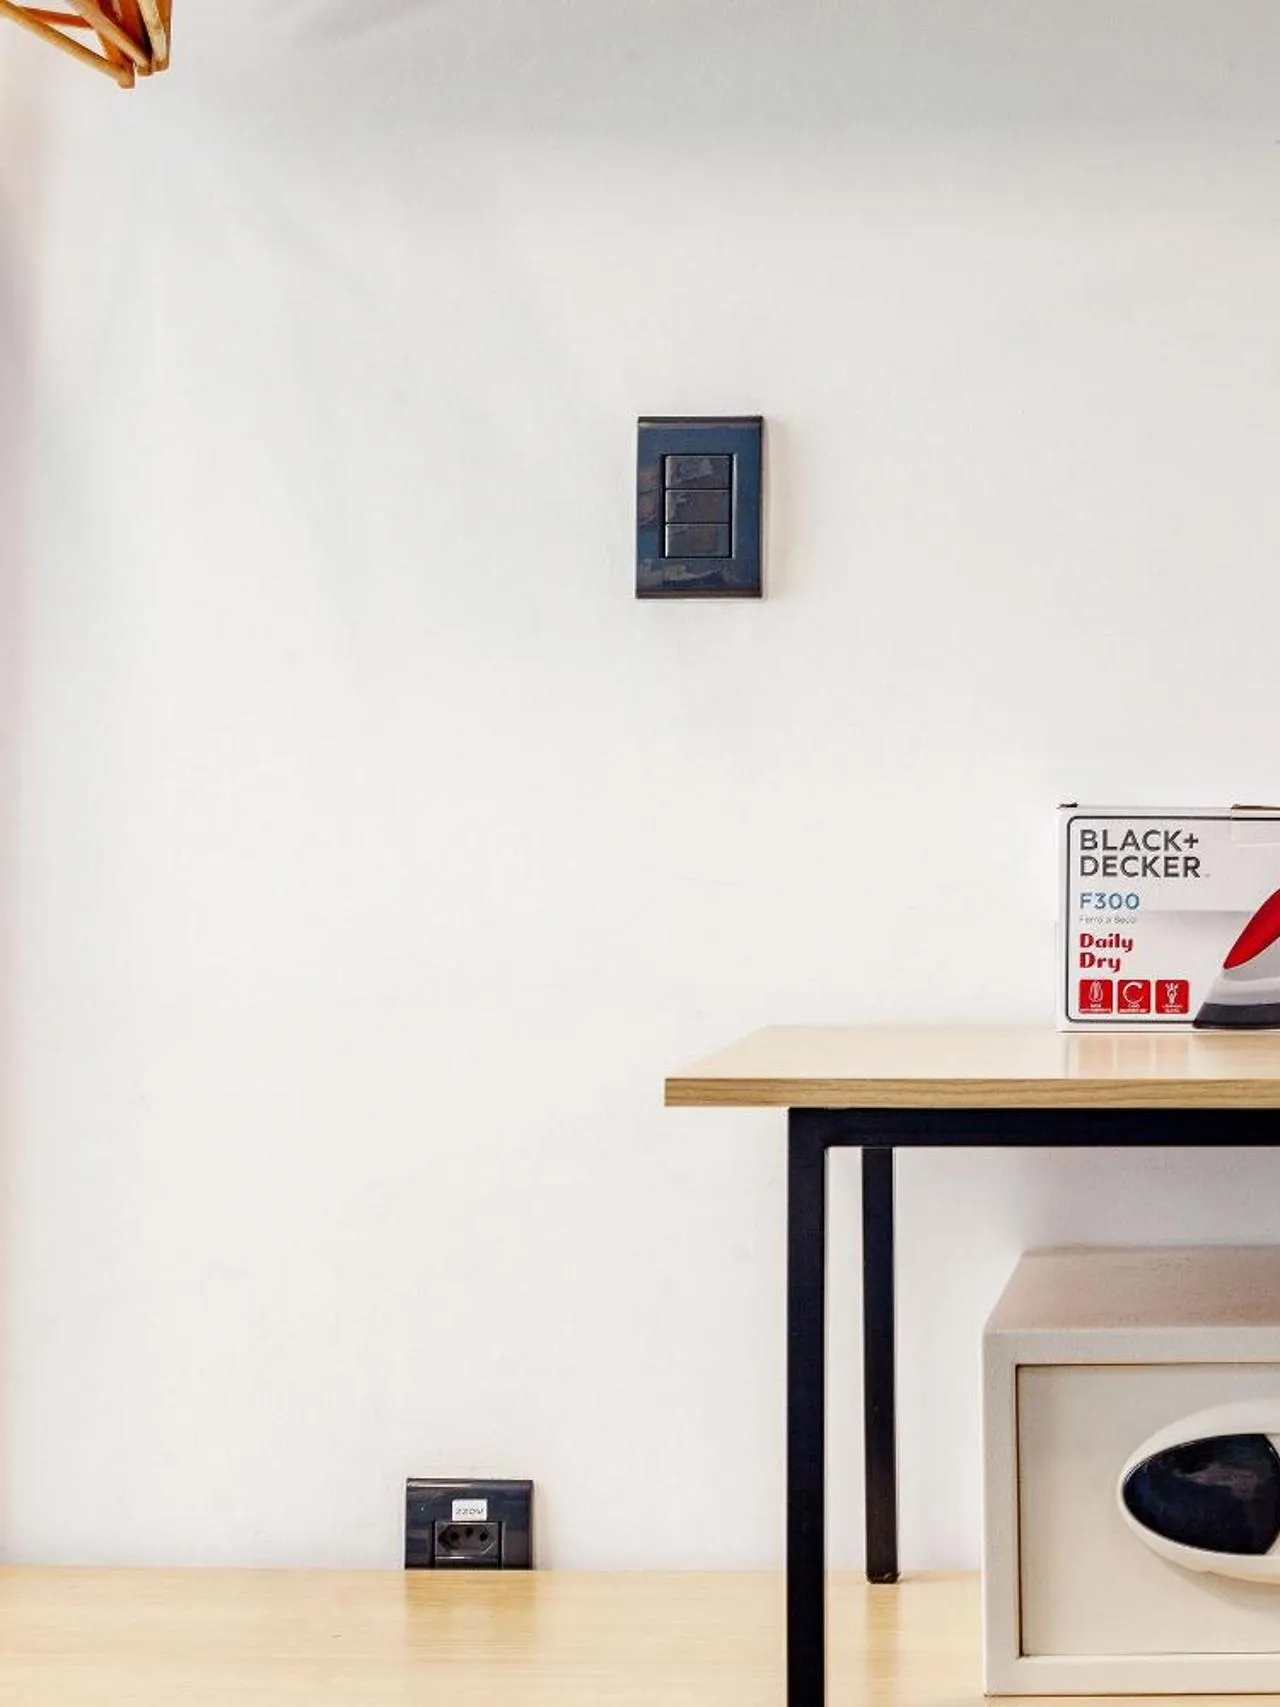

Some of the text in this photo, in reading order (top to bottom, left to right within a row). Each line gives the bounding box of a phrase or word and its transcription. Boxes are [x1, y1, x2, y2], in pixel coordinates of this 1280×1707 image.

[1080, 829, 1199, 851] BLACK+
[1080, 855, 1200, 878] DECKER
[1080, 893, 1139, 909] F300
[1080, 933, 1133, 953] Daily
[1080, 952, 1121, 973] Dry
